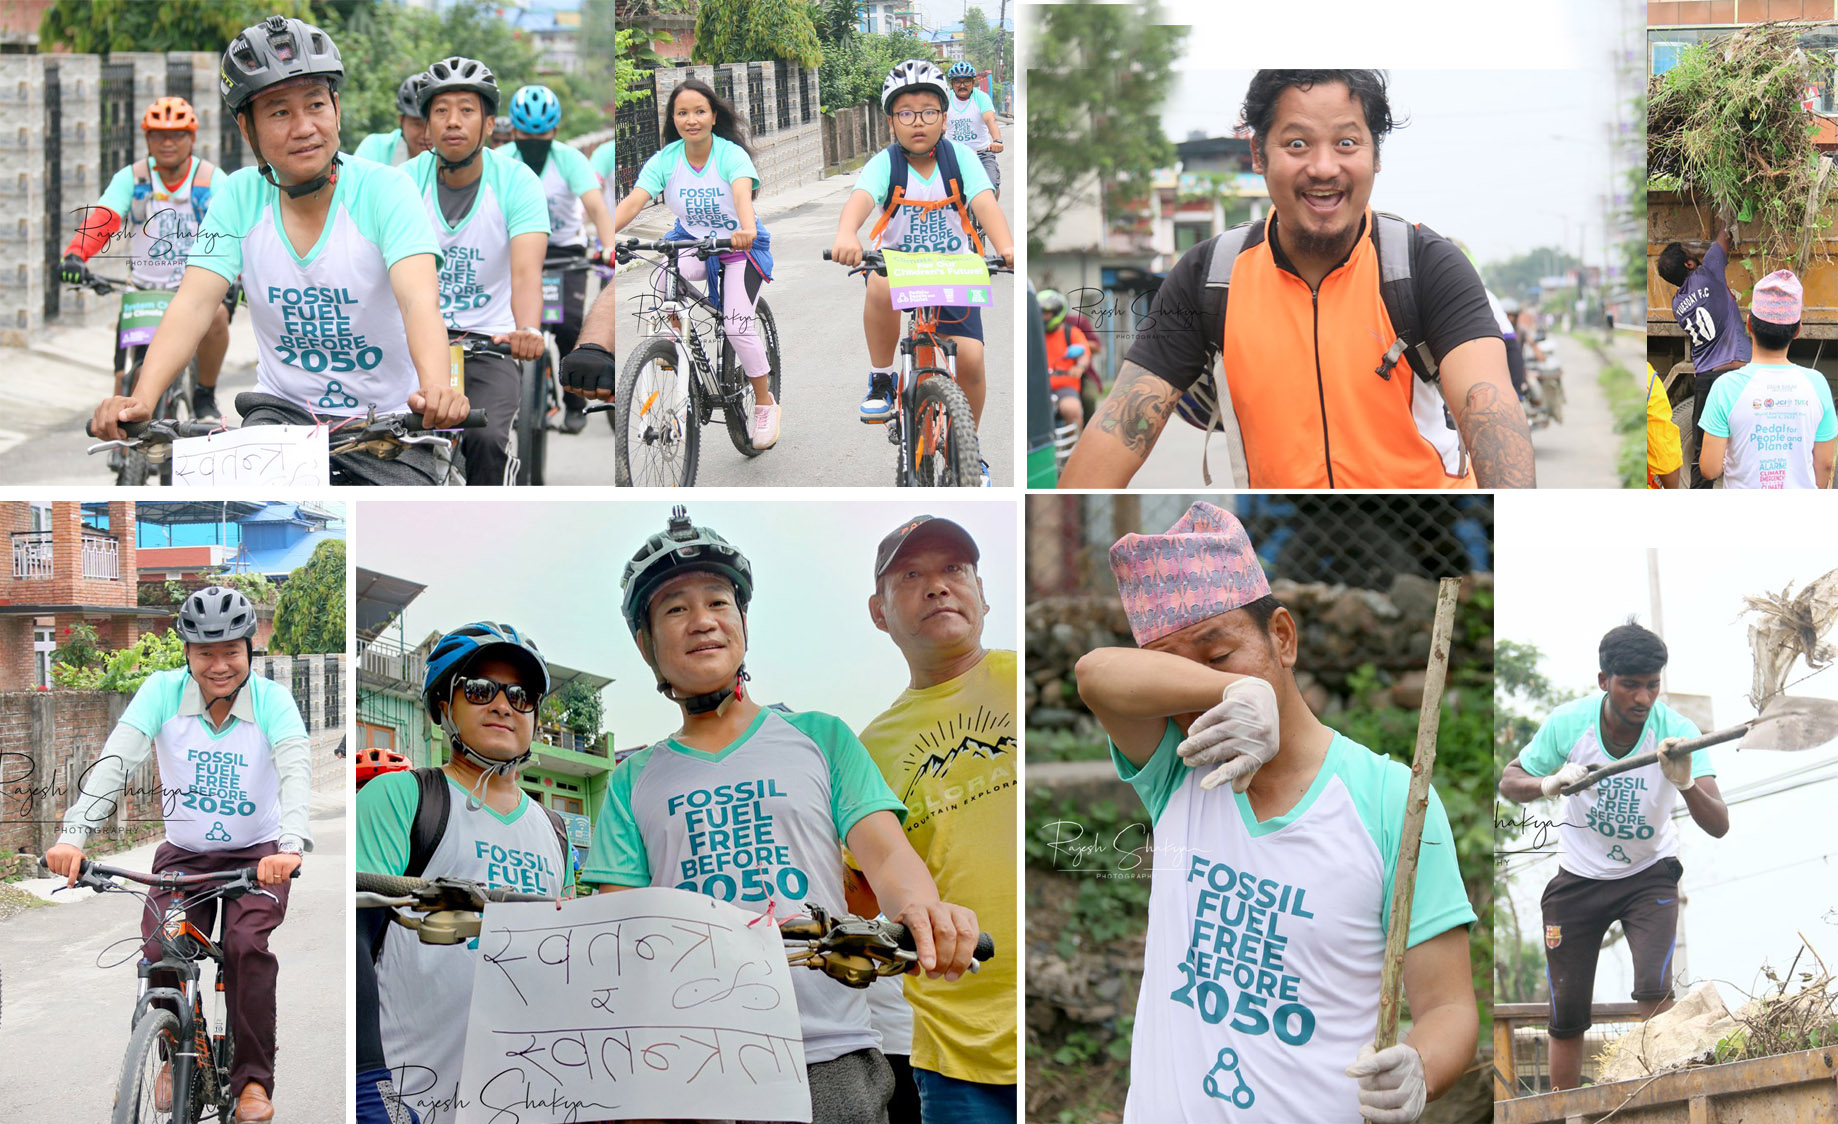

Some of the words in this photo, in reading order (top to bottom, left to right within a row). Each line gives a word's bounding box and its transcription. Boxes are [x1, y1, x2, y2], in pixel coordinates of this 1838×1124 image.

[680, 187, 725, 198] FOSSIL
[686, 198, 720, 207] FUEL
[686, 207, 721, 215] FREE
[904, 228, 954, 244] BEFORE
[910, 221, 947, 234] FREE
[444, 259, 476, 273] UEL
[439, 271, 476, 286] REE
[268, 286, 359, 305] FOSSIL
[439, 293, 491, 310] 050
[1676, 291, 1698, 317] TUESDAY
[281, 303, 350, 321] FUEL
[284, 321, 353, 338] FREE
[1684, 306, 1716, 347] 10
[279, 334, 368, 351] BEFORE
[274, 345, 383, 373] 2050
[1750, 432, 1785, 443] People
[1755, 424, 1785, 433] Pedal
[1757, 441, 1793, 451] Planet
[187, 749, 249, 767] FOSSIL
[195, 762, 241, 778] FUEL
[195, 774, 241, 790] FREE
[1598, 777, 1648, 791] OSSIL
[188, 784, 248, 801] BEFORE
[668, 778, 788, 817] FOSSIL
[1597, 788, 1641, 802] FUEL
[181, 793, 256, 817] 2050
[685, 800, 773, 833] FUEL
[1590, 806, 1646, 825] BEFORE
[1585, 812, 1655, 840] 2050
[688, 822, 775, 857] FREE
[475, 840, 555, 878] FOSSIL
[680, 845, 791, 880] BEFORE
[487, 862, 547, 893] FUEL
[1187, 855, 1315, 920] FOSSIL
[1196, 889, 1288, 944] FUEL
[1192, 918, 1286, 972] FREE
[1169, 961, 1316, 1047] 2050
